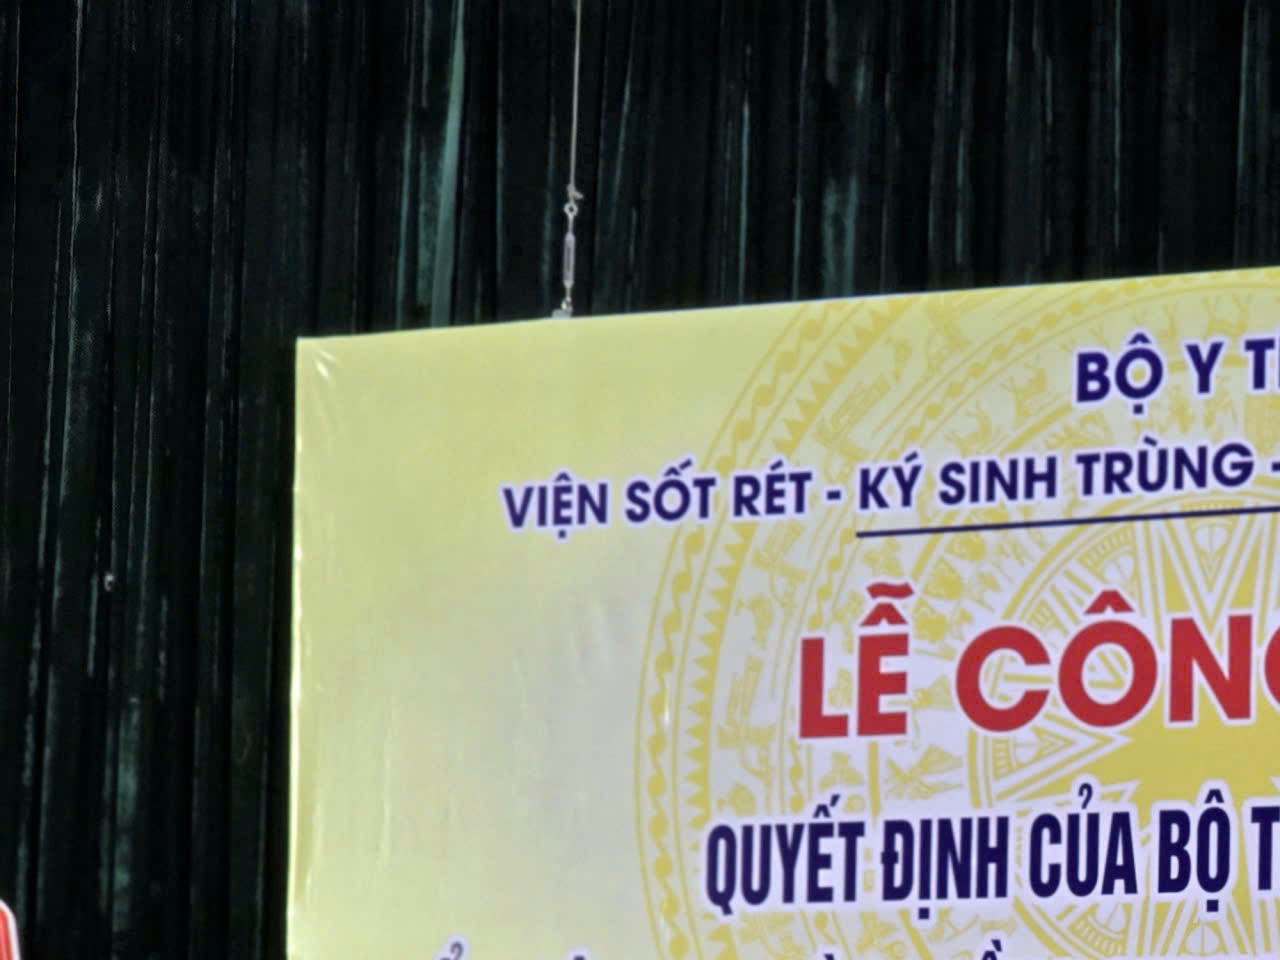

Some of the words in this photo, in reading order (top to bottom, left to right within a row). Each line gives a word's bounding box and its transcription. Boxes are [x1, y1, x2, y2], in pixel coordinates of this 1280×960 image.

[1078, 334, 1162, 414] BỘ
[1187, 343, 1222, 393] Y
[504, 474, 606, 537] VIỆN
[627, 460, 715, 522] SỐT
[734, 461, 811, 516] RÉT
[860, 453, 921, 509] KÝ
[940, 457, 1056, 504] SINH
[1077, 437, 1253, 495] TRÙNG
[802, 584, 912, 736] LỄ
[707, 795, 864, 915] QUYẾT
[881, 817, 1008, 919] ĐỊNH
[1030, 784, 1137, 897] CỦA
[1158, 789, 1230, 912] BỘ
